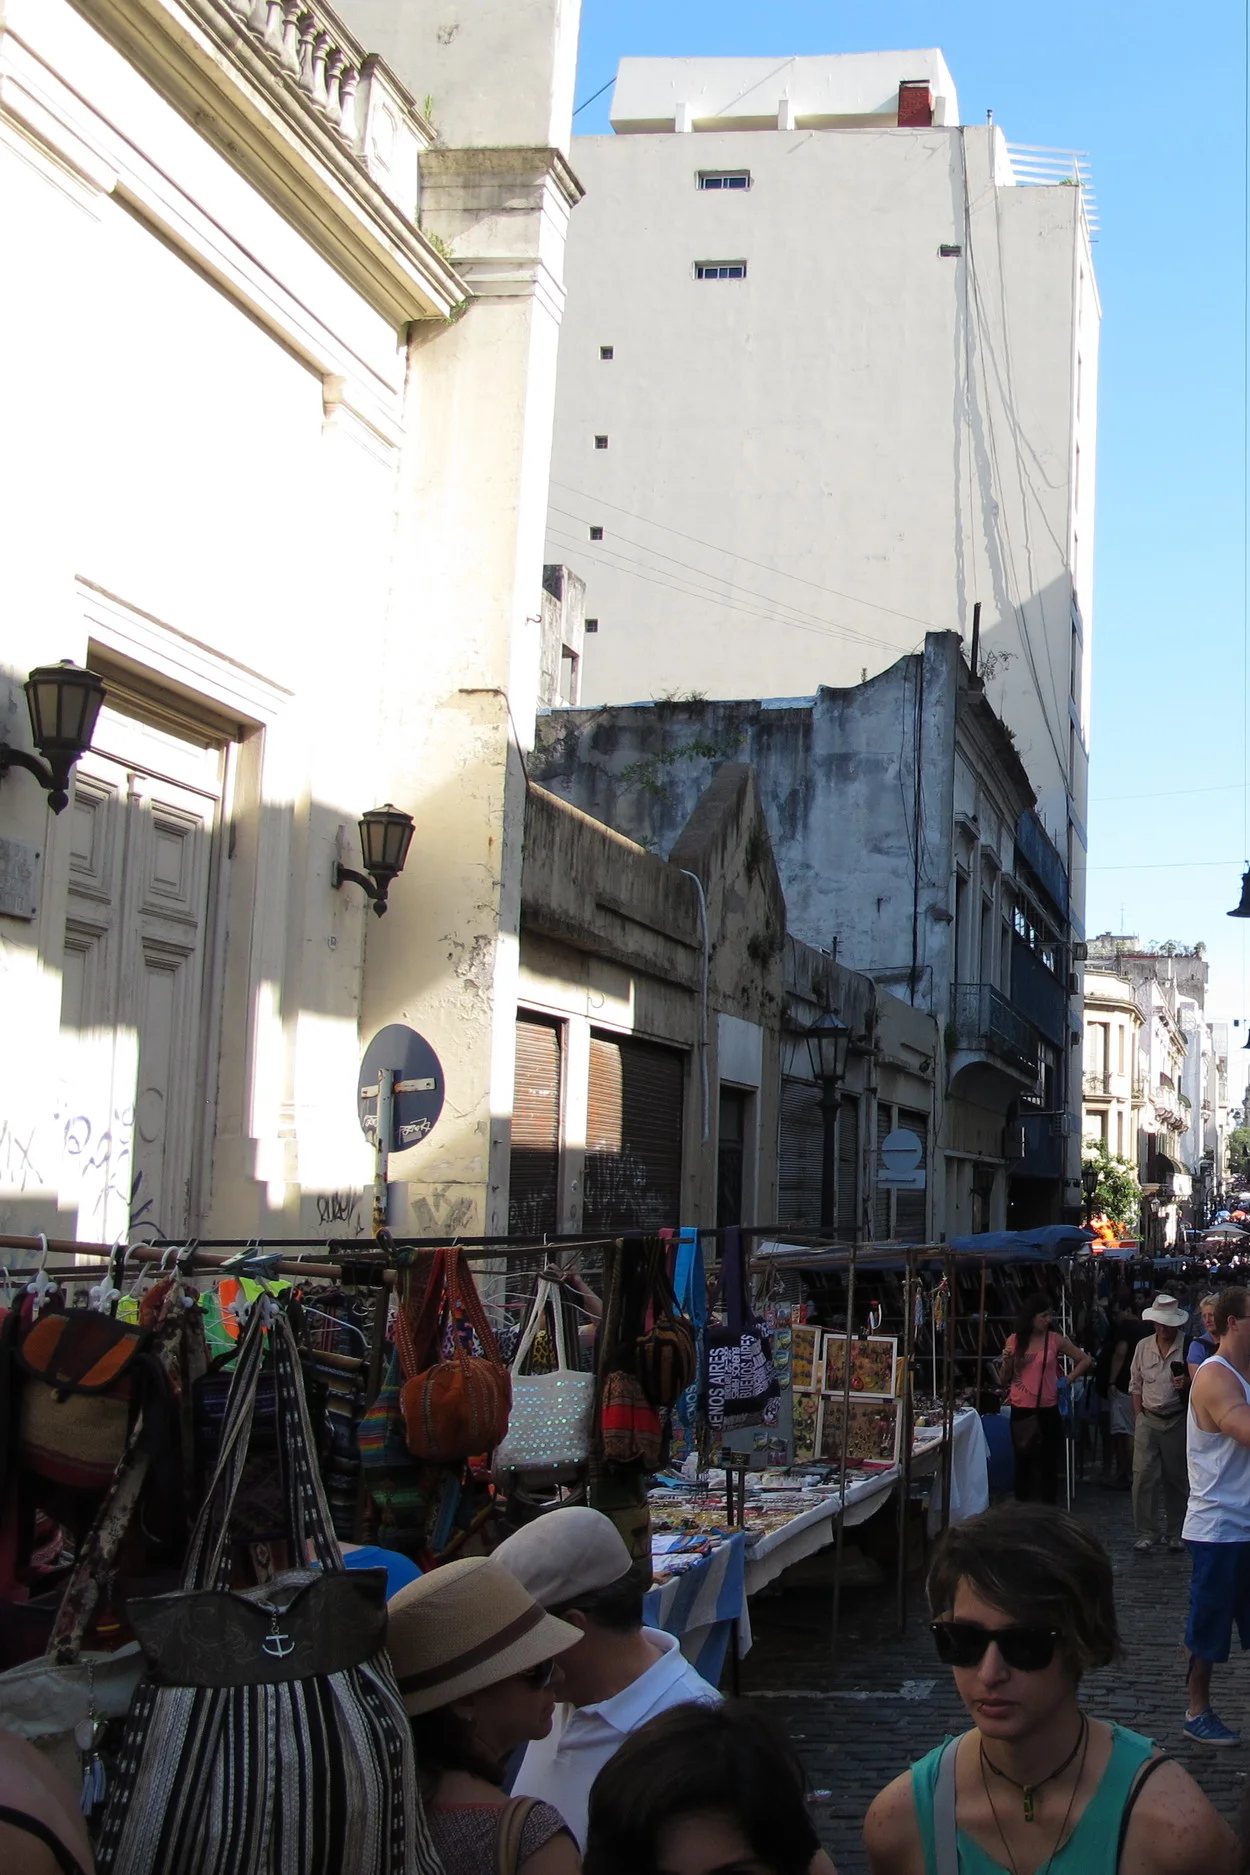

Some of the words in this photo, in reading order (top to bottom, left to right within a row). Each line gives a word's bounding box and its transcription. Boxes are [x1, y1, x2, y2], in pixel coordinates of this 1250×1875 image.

[708, 1347, 726, 1386] AIRES
[740, 1334, 755, 1361] AIRES
[739, 1361, 755, 1399] BUENOS
